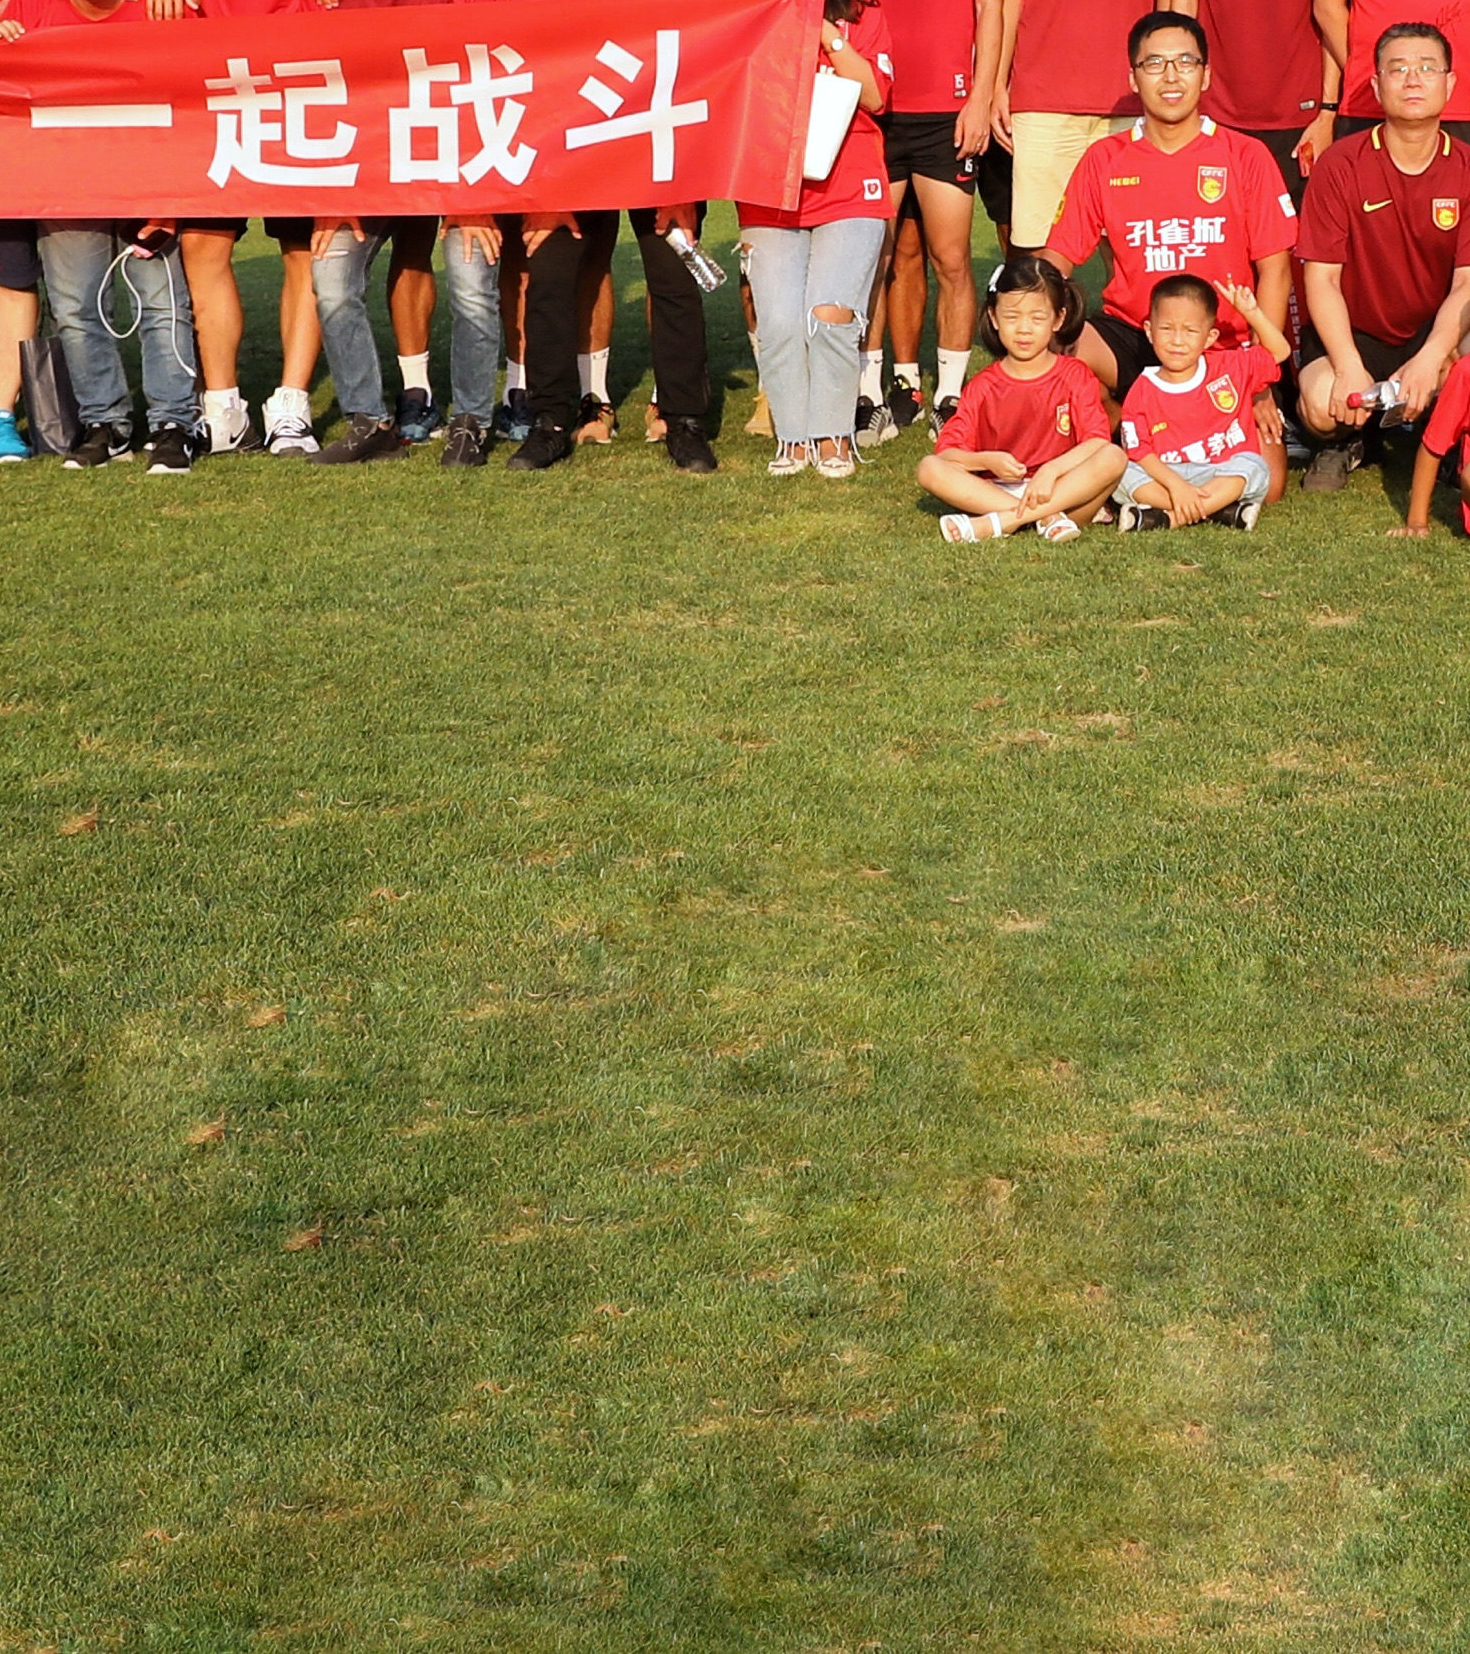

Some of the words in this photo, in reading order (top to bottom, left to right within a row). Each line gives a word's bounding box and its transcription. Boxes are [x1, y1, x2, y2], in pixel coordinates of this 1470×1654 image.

[31, 30, 708, 188] 一起战斗
[1109, 176, 1140, 186] HEBEI
[1126, 217, 1227, 247] 孔雀城
[1144, 244, 1207, 272] 地产
